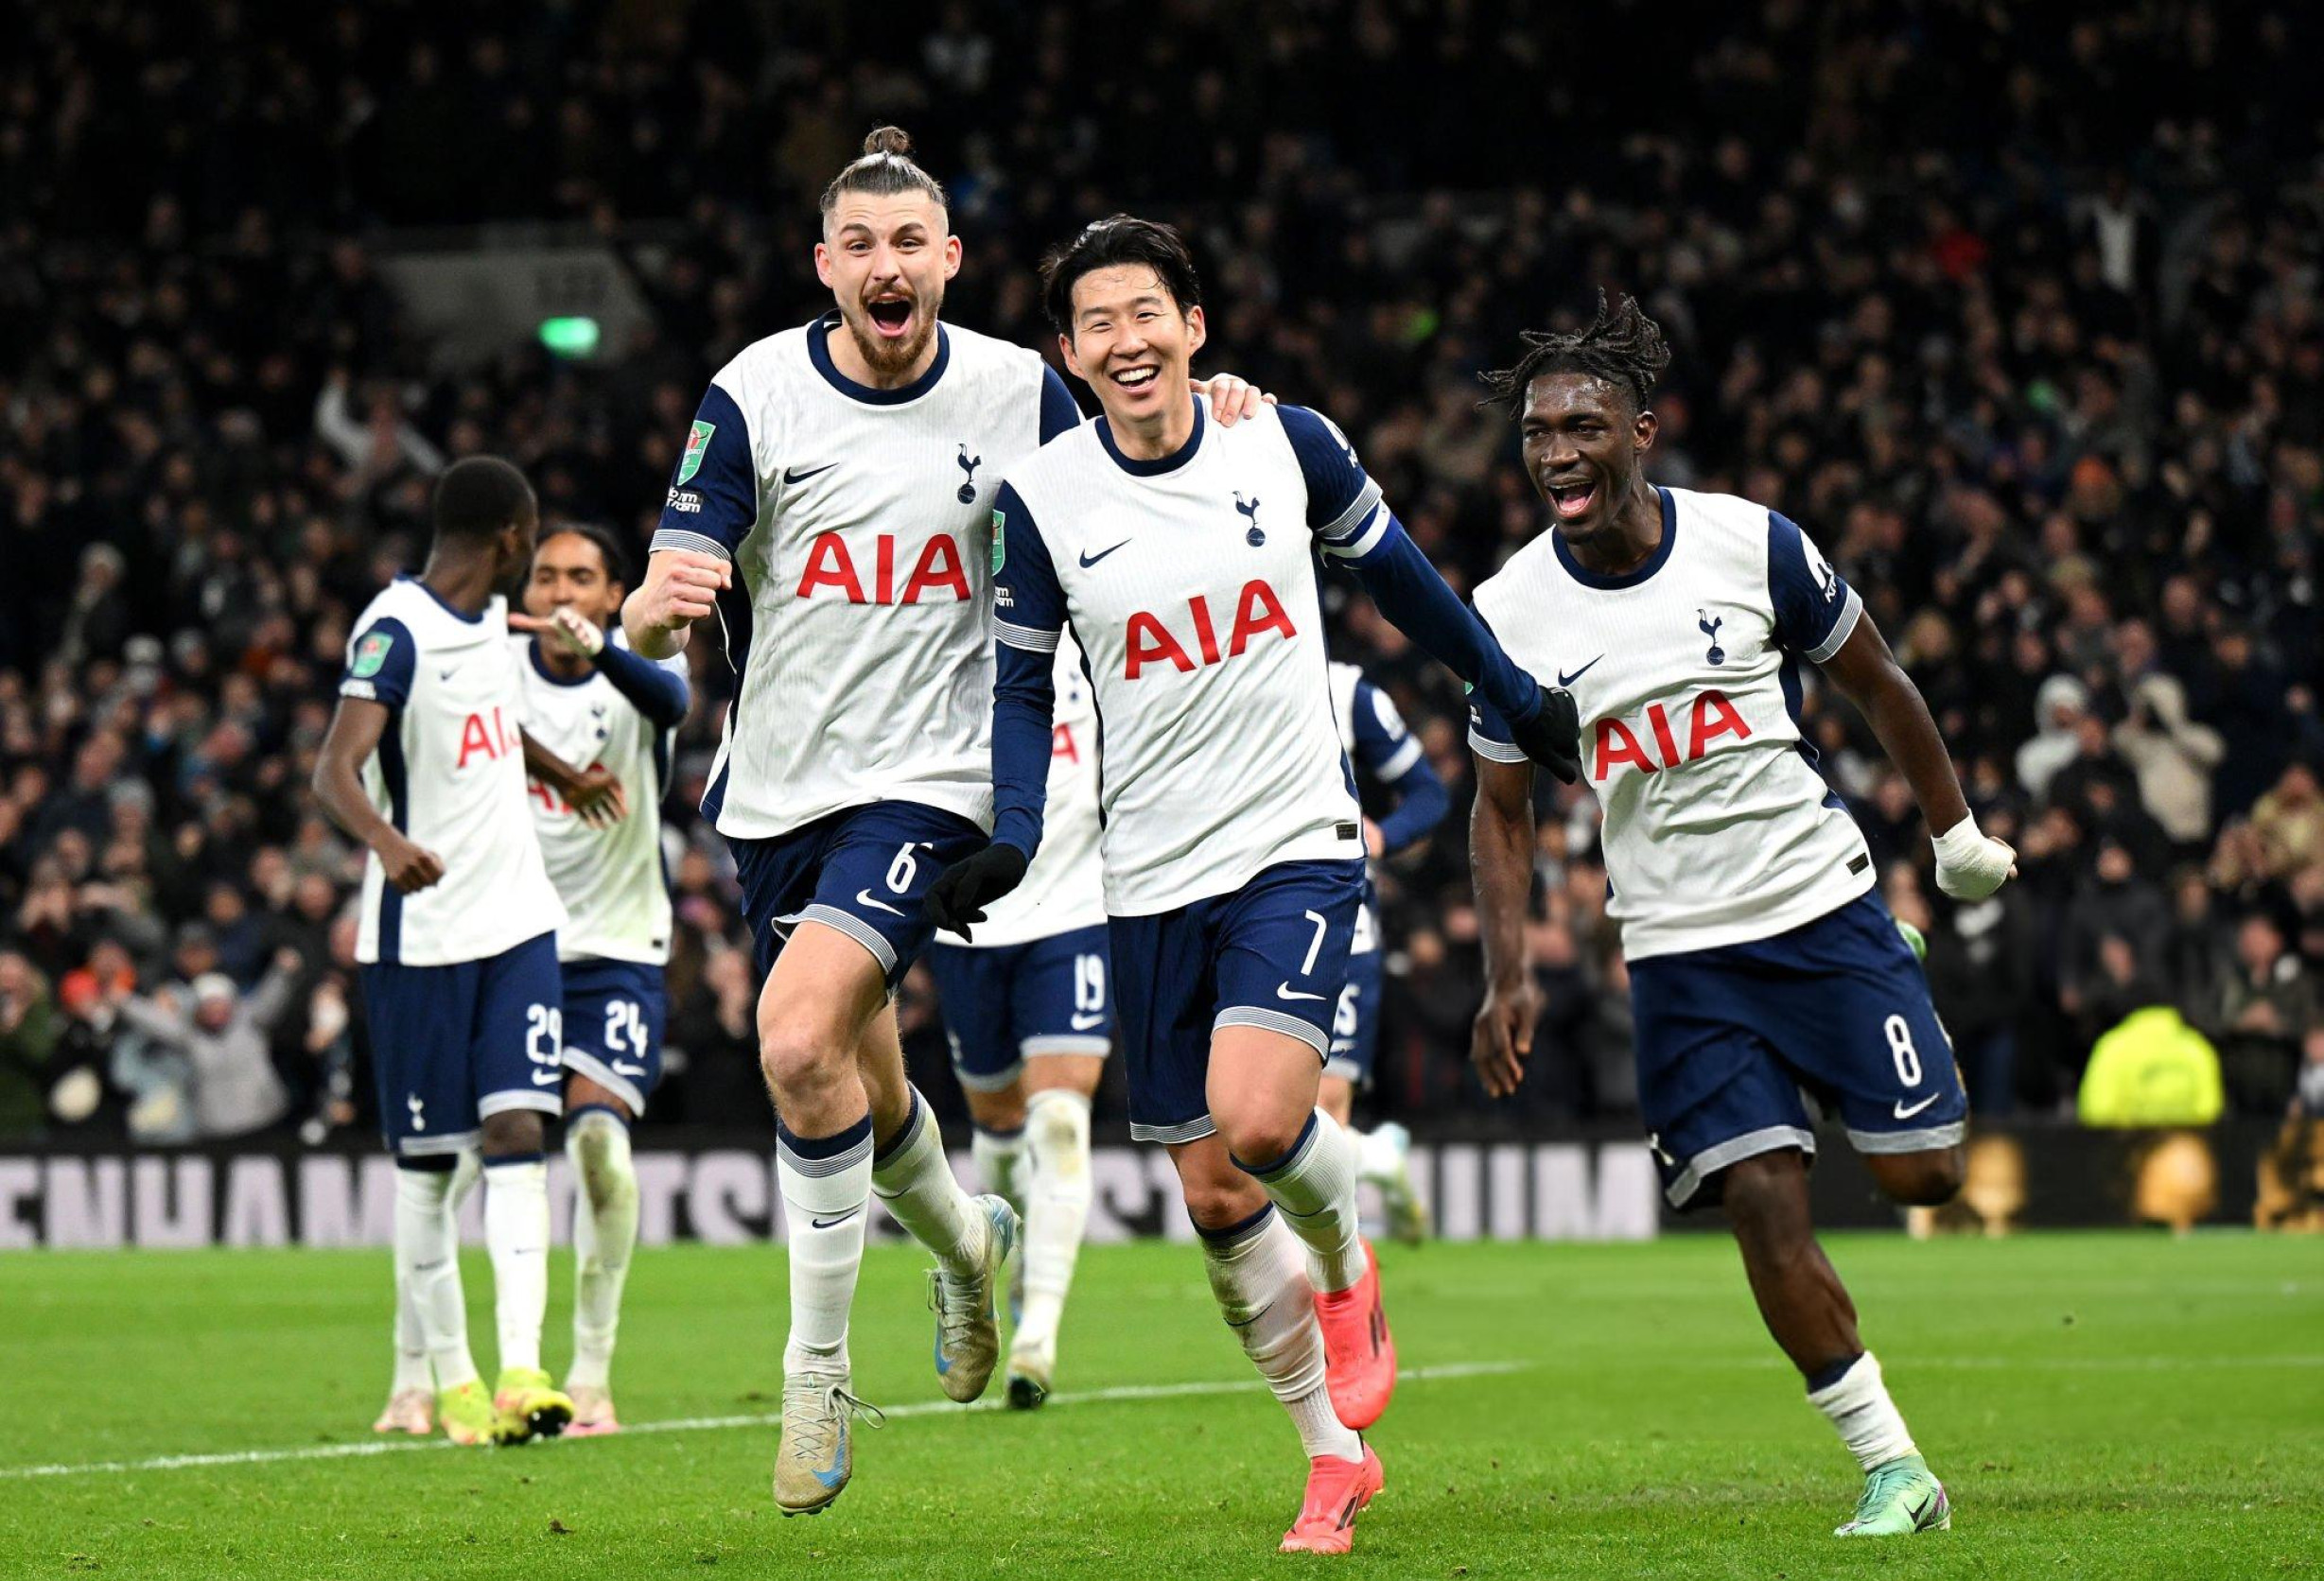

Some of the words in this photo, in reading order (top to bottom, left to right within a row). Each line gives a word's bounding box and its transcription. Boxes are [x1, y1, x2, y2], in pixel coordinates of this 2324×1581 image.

[795, 532, 971, 604] AIA
[1125, 579, 1297, 680] AIA
[456, 705, 522, 770] AI
[1595, 689, 1752, 781] AIA
[885, 842, 934, 895] 6
[1300, 909, 1327, 976] 7
[1075, 953, 1105, 1012] 19
[526, 1002, 563, 1067] 29
[604, 999, 649, 1060] 24
[1884, 1014, 1922, 1087] 8
